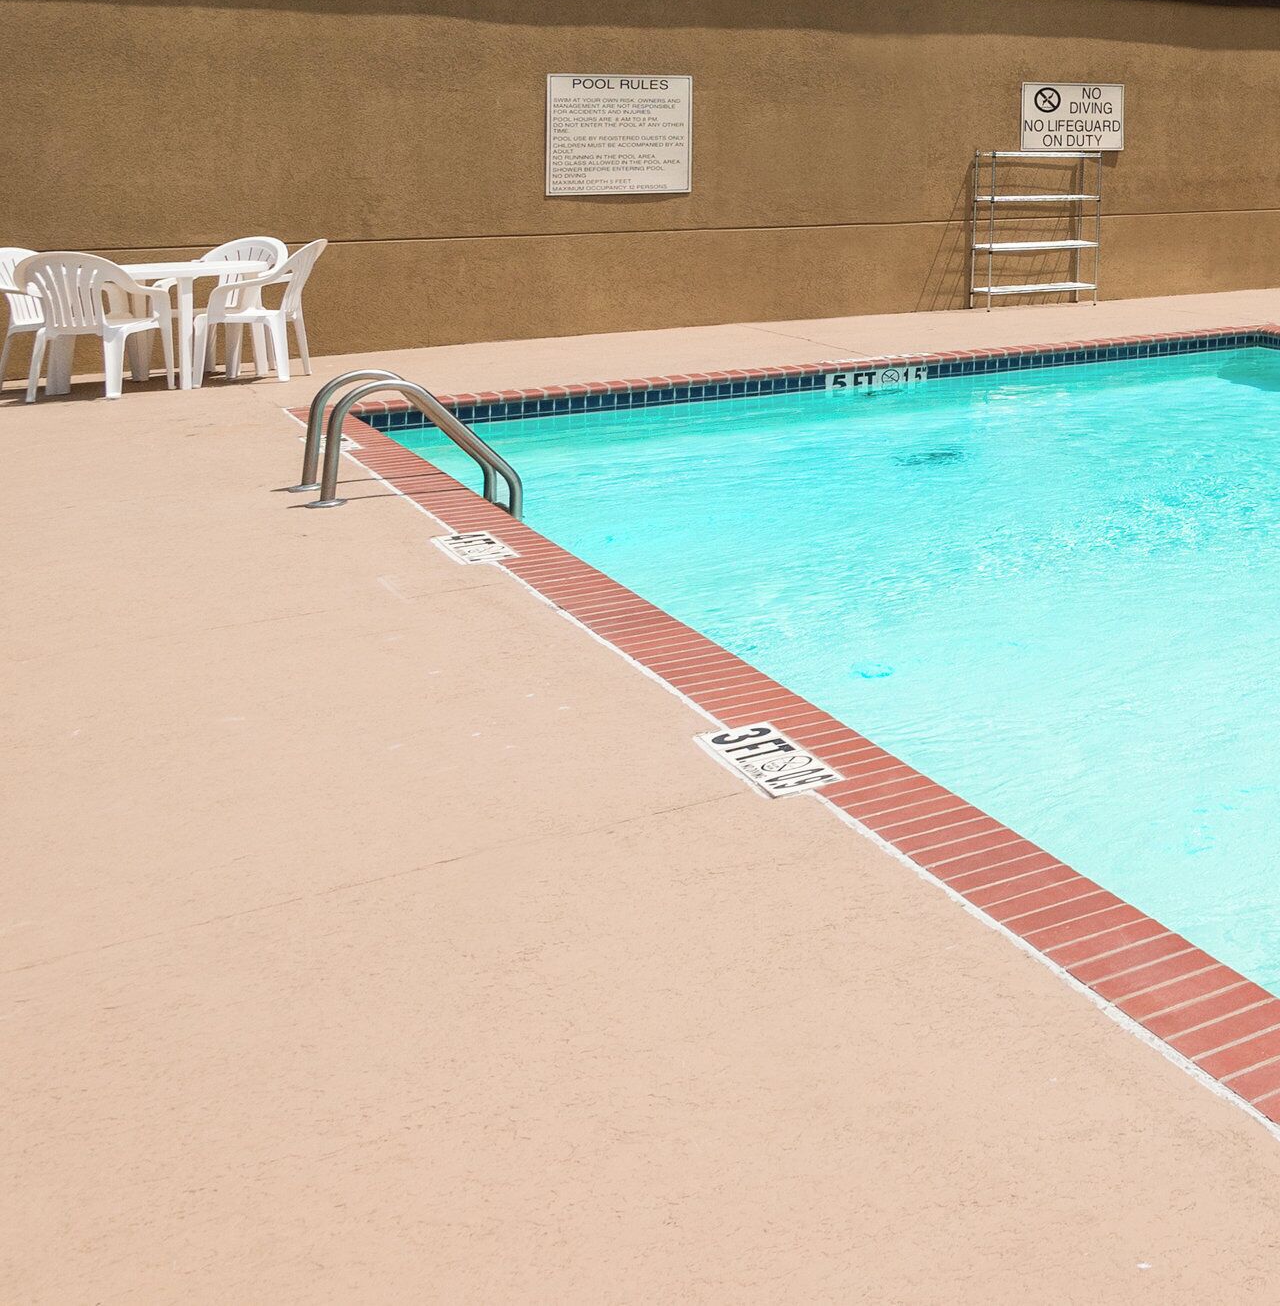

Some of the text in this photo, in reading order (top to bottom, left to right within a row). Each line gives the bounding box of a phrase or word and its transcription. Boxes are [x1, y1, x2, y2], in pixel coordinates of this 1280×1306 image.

[572, 79, 669, 90] POOL RULES
[1082, 87, 1102, 100] NO
[1069, 102, 1113, 114] DIVING
[1024, 119, 1121, 132] NO LIFEGUARD
[1042, 134, 1103, 147] ON DUTY
[832, 374, 847, 388] 5
[853, 371, 877, 387] FT
[711, 727, 772, 745] 3
